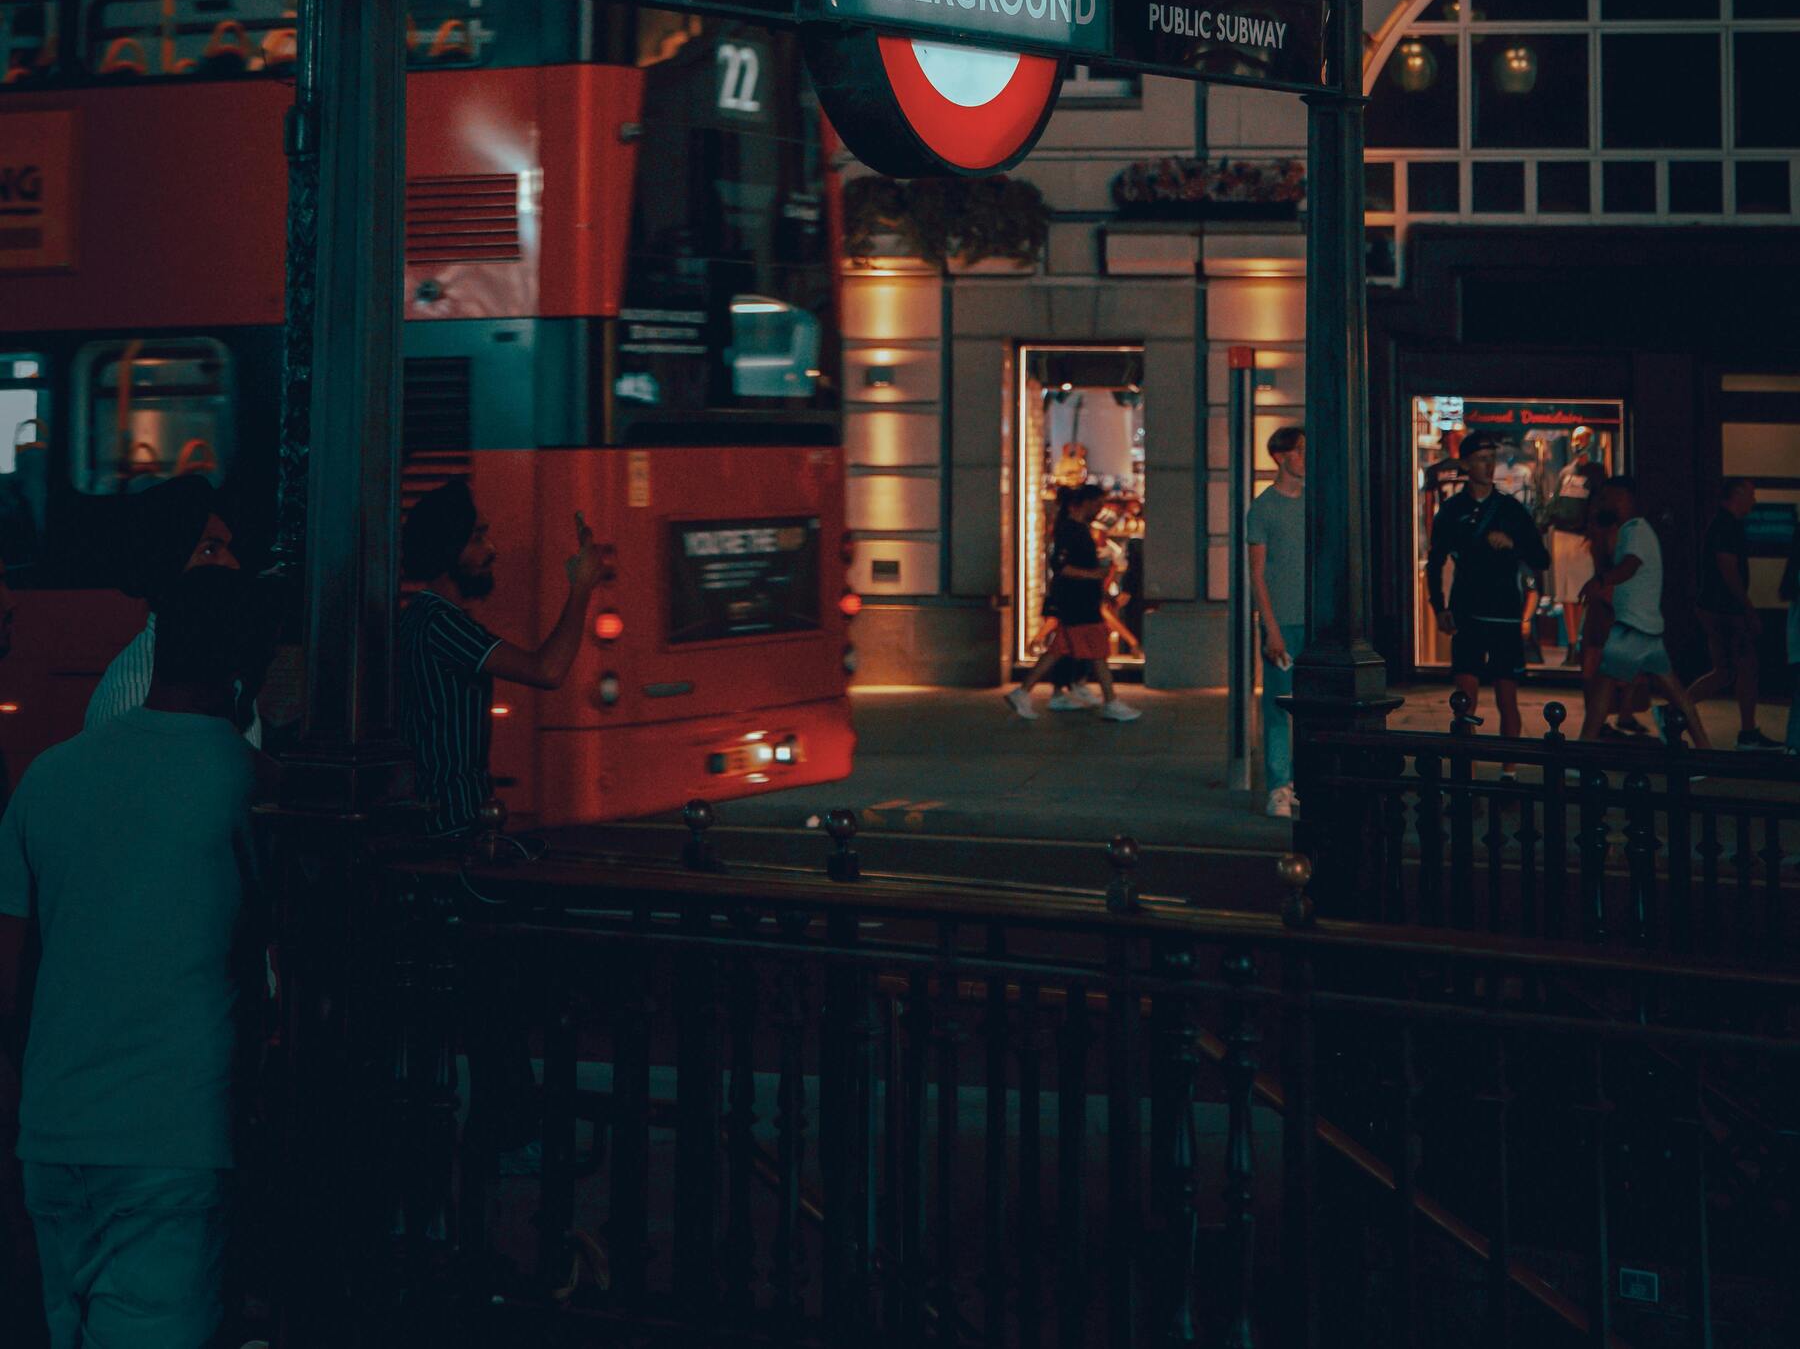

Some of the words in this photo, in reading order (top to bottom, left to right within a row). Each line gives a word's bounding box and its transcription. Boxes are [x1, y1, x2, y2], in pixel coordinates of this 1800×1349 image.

[1149, 3, 1211, 39] PUBLIC
[1216, 12, 1287, 49] SUBWAY
[716, 43, 761, 112] 22
